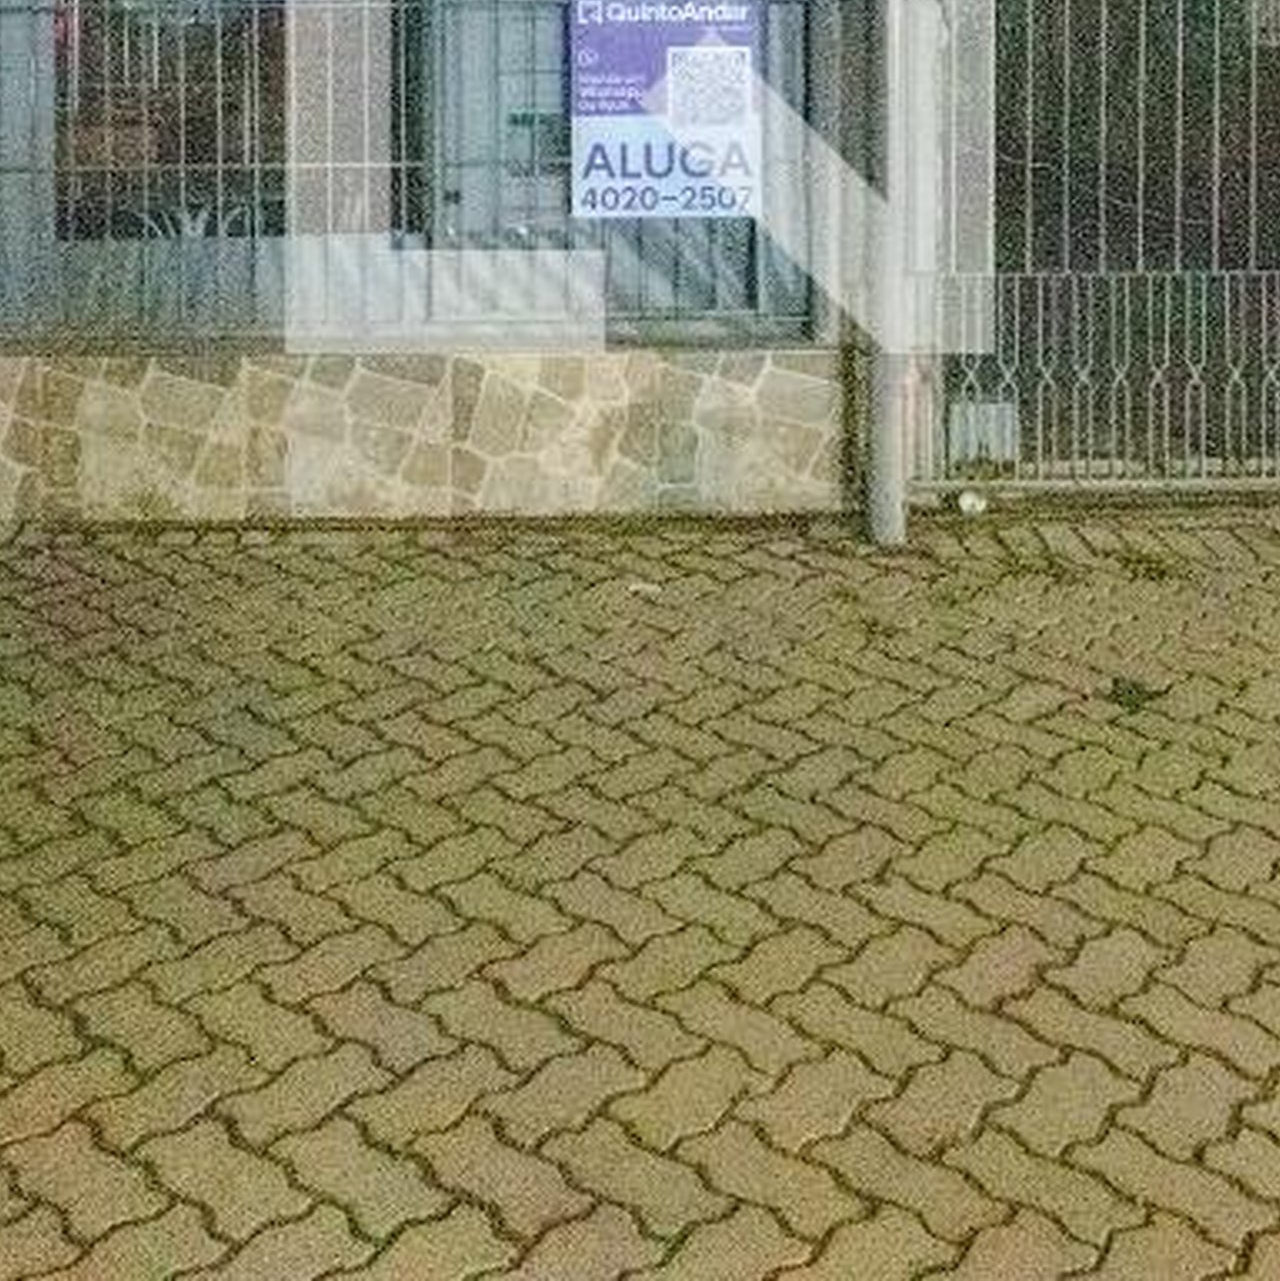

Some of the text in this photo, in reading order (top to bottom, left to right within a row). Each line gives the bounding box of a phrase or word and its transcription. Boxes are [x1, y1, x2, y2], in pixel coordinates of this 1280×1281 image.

[606, 1, 750, 24] QuintoAndar
[582, 142, 752, 179] ALUGA
[581, 185, 753, 212] 4020-2507
